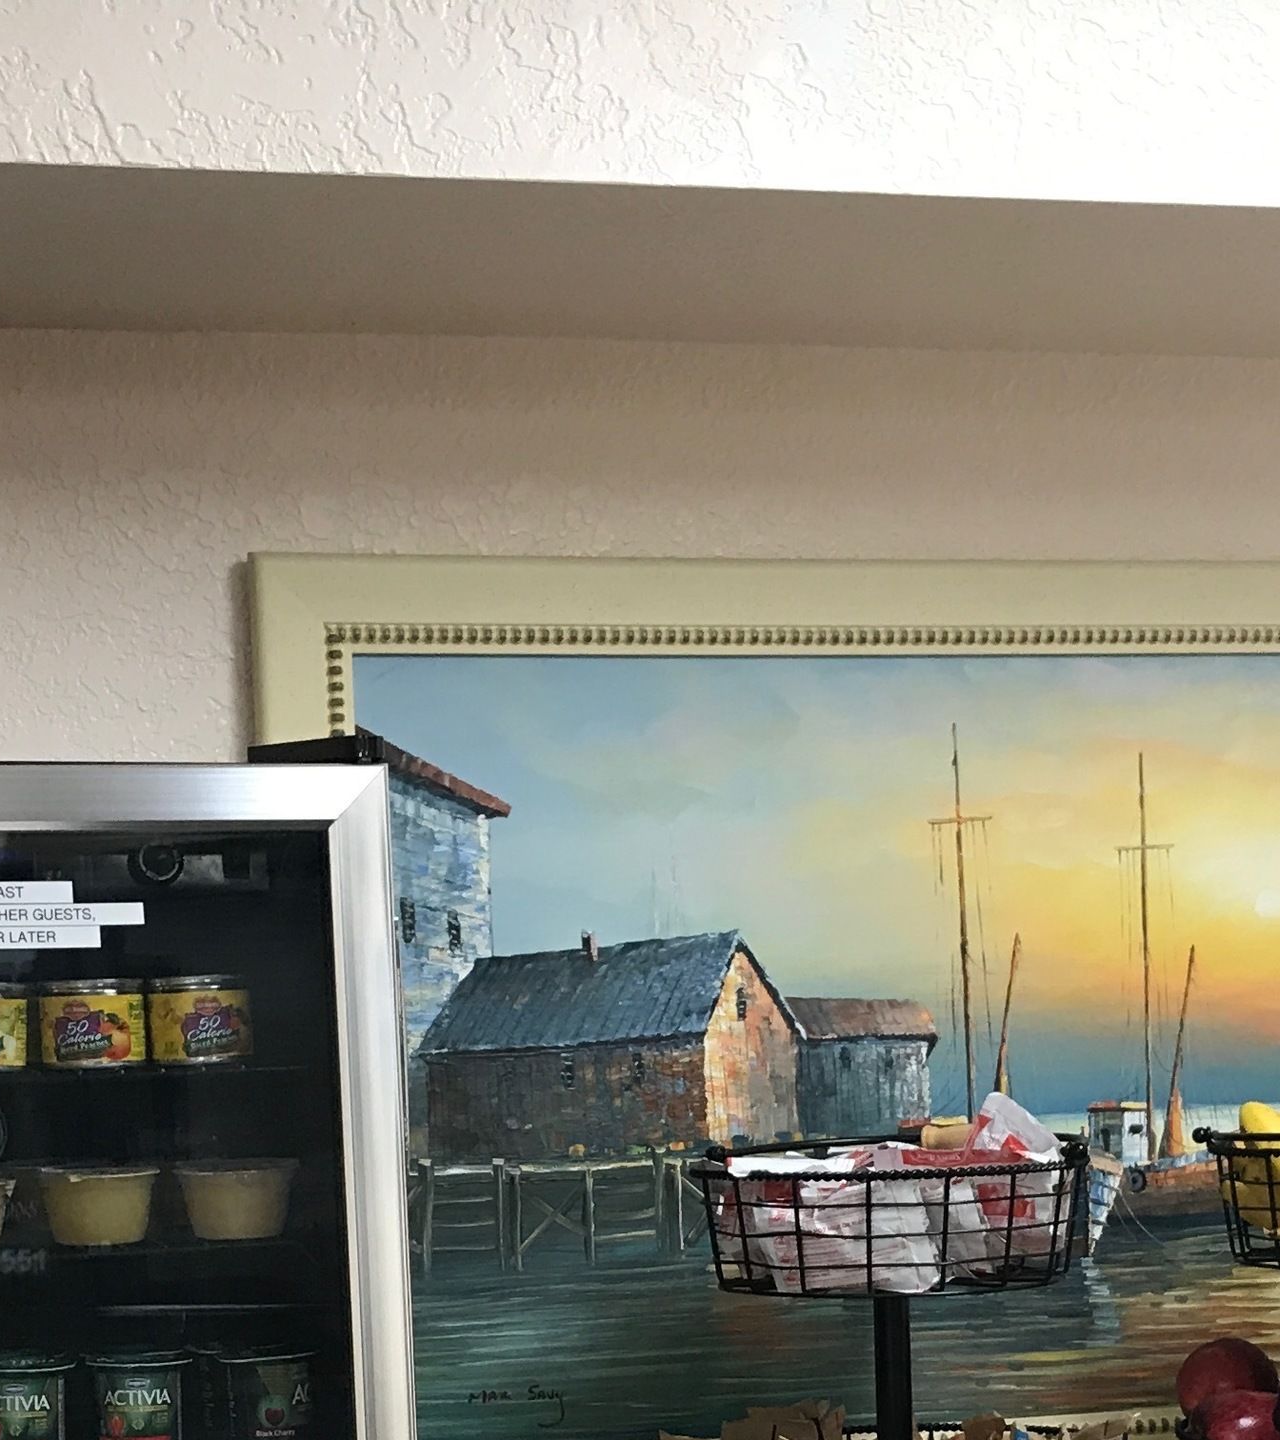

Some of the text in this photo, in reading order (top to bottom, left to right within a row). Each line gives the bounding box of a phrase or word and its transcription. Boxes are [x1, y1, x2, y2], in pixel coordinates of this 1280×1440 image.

[32, 907, 97, 922] GUESTS,
[8, 930, 57, 943] LATER
[66, 1019, 89, 1035] 50
[199, 1016, 221, 1031] 50
[57, 1032, 102, 1045] Calorie
[187, 1029, 233, 1043] Calorie
[104, 1389, 171, 1406] ACTIVIA
[256, 1430, 273, 1438] Black
